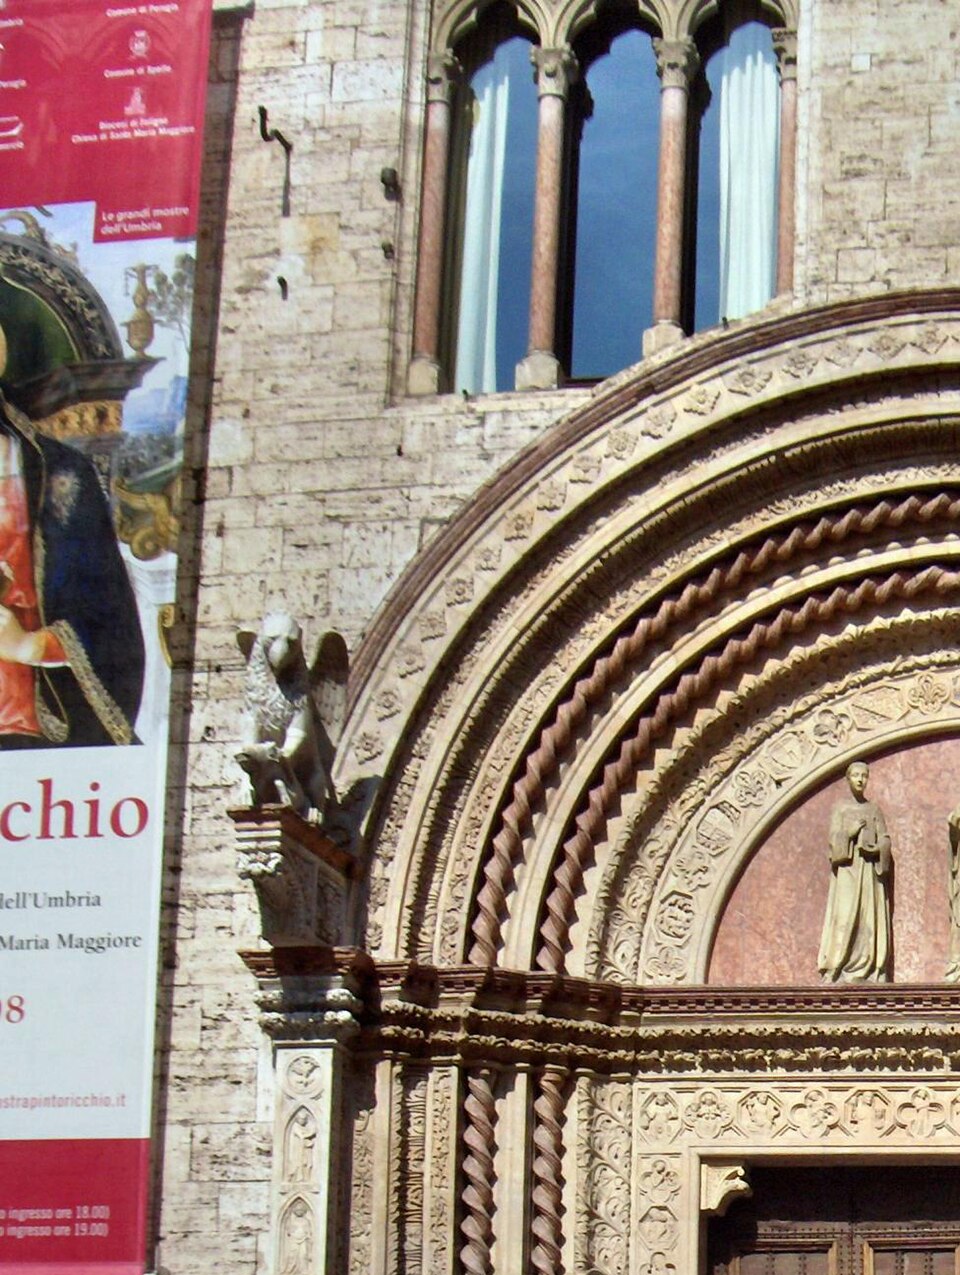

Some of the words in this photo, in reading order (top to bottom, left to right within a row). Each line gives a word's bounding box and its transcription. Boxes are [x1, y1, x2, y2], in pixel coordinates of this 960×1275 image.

[102, 211, 114, 221] Le
[116, 207, 150, 222] grandi
[152, 206, 189, 217] mostre
[101, 219, 162, 235] dell'Umbria
[0, 777, 149, 842] chio
[0, 933, 50, 951] Maria
[57, 932, 142, 954] Maggiore
[0, 994, 25, 1024] 8
[8, 1206, 53, 1222] ingresso
[55, 1208, 73, 1219] ore
[7, 1224, 52, 1239] ingresso
[53, 1225, 71, 1236] ore
